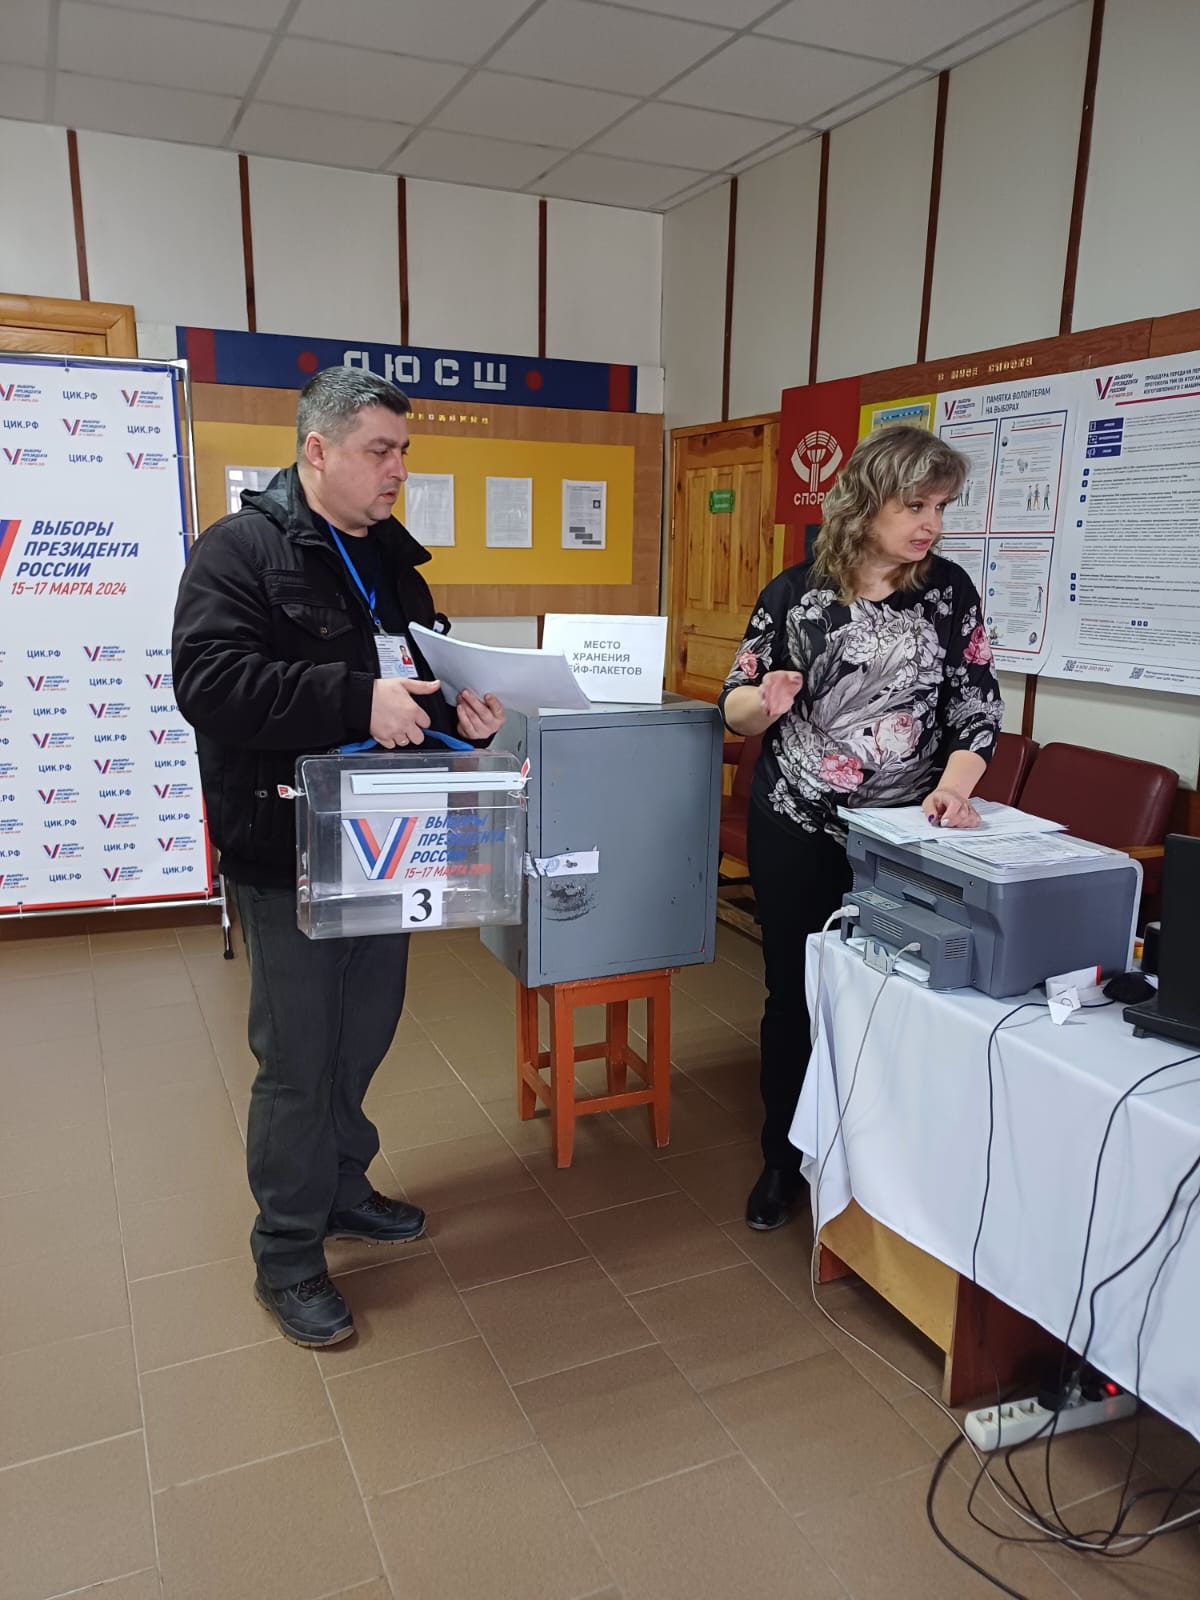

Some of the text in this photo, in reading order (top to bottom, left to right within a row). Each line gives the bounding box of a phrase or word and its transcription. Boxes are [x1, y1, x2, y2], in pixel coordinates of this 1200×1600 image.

[63, 390, 97, 400] ЦИК.РФ
[1012, 386, 1051, 400] ВОЛОНТЕРАМ
[3, 419, 39, 429] ЦИК.РФ
[127, 425, 161, 434] ЦИК.РФ
[69, 454, 103, 463] ЦИК.РФ
[794, 491, 831, 506] СПОР
[31, 520, 114, 536] ВЫБОРЫ
[24, 541, 139, 559] ПРЕЗИДЕНТА
[16, 562, 91, 577] РОССИИ
[49, 582, 94, 596] МАРТА
[96, 583, 127, 595] 2024
[583, 640, 621, 649] МЕСТО
[27, 650, 61, 659] ЦИК.РФ
[146, 649, 172, 658] ЦИК.Р
[572, 652, 630, 662] ХРАНЕНИЯ
[568, 663, 642, 675] ЕЙФ-ПАКЕТОВ
[89, 678, 122, 687] ЦИК.РФ
[33, 707, 67, 717] ЦИК.РФ
[94, 734, 127, 743] ЦИК.РФ
[38, 764, 72, 773] ЦИК.РФ
[155, 760, 187, 768] ЦИК.РФ
[99, 789, 132, 798] ЦИК.РФ
[159, 813, 190, 822] ЦИК.РФ
[44, 819, 77, 828] ЦИК.РФ
[425, 816, 488, 829] ВЫЫ
[417, 832, 506, 846] ПРЕЗНТА
[104, 843, 136, 852] ЦИК.РФ
[0, 850, 21, 858] К.РФ
[410, 850, 468, 863] РОСС
[163, 866, 194, 875] ЦИК.РФ
[49, 873, 81, 882] ЦИК.РФ
[410, 888, 433, 922] 3
